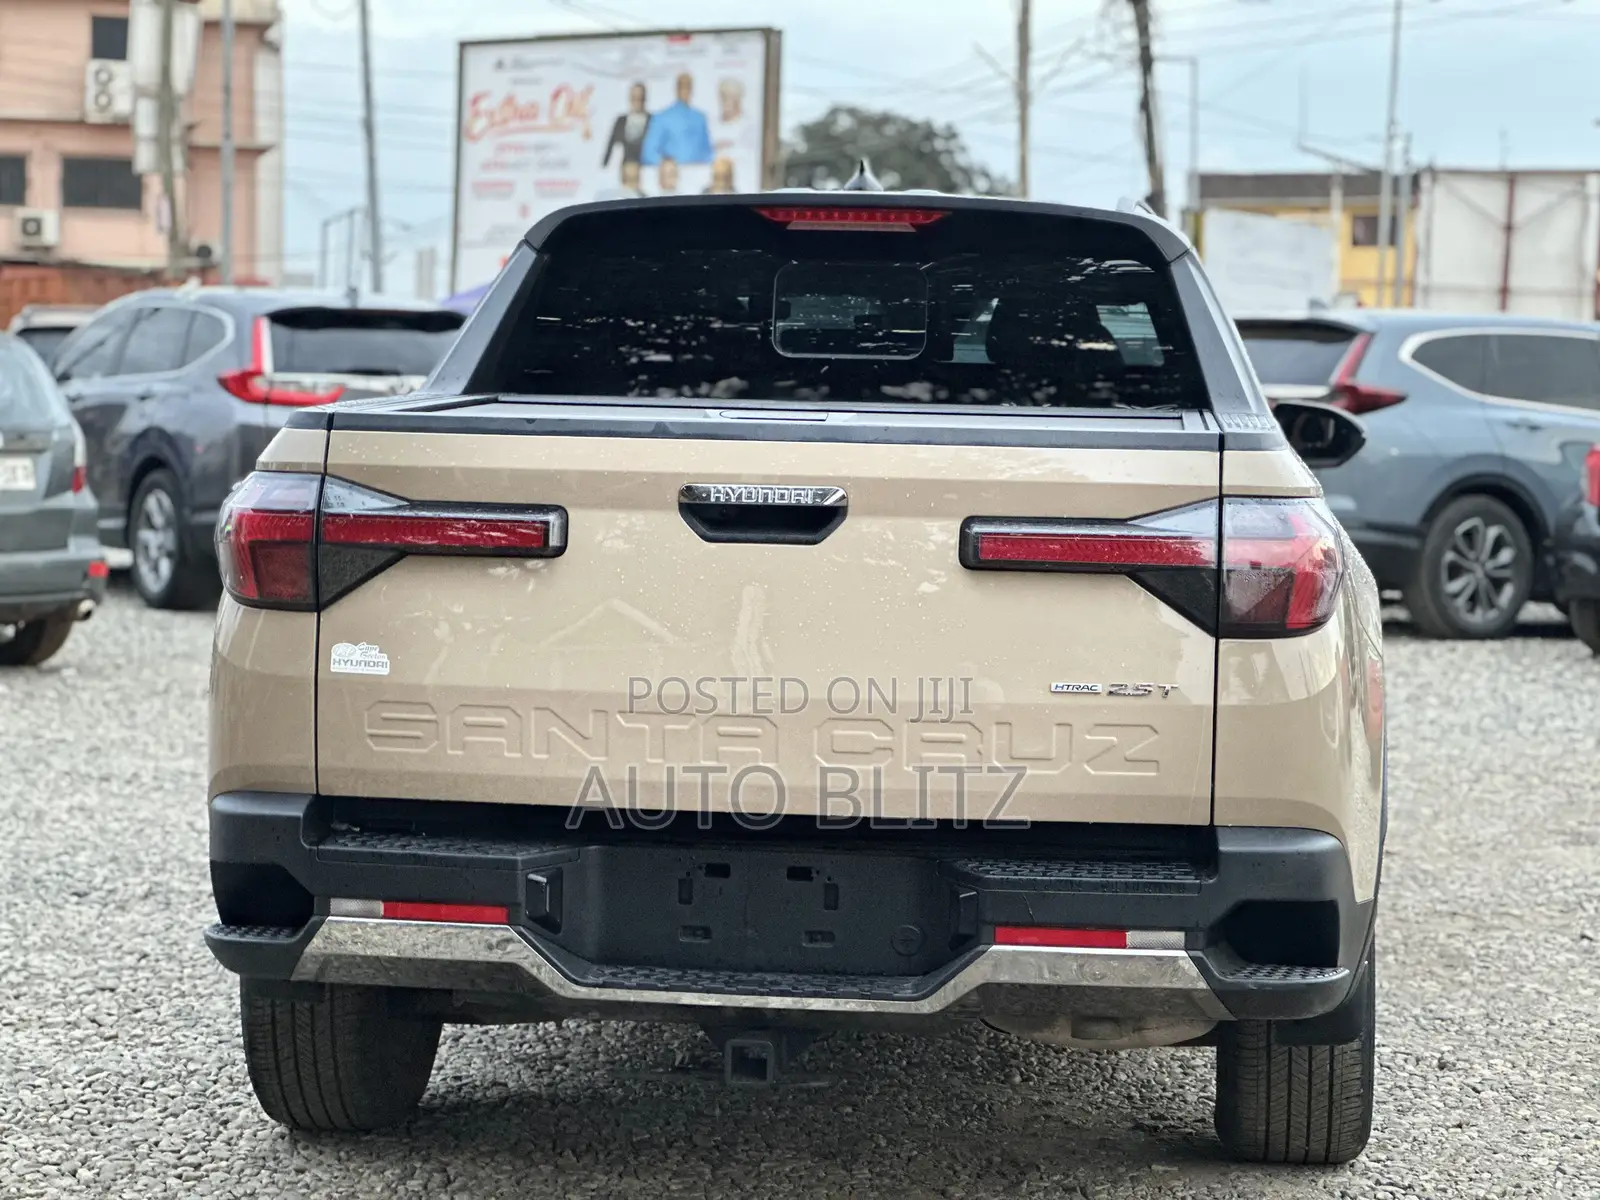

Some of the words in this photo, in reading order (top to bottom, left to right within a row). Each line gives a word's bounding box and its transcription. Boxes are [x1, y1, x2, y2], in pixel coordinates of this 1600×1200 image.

[709, 486, 815, 504] HYUNDAI
[332, 658, 388, 668] HYUNDAI
[1054, 683, 1099, 692] HTRAC
[365, 700, 779, 765] SANTA
[814, 716, 1160, 776] CRUZ
